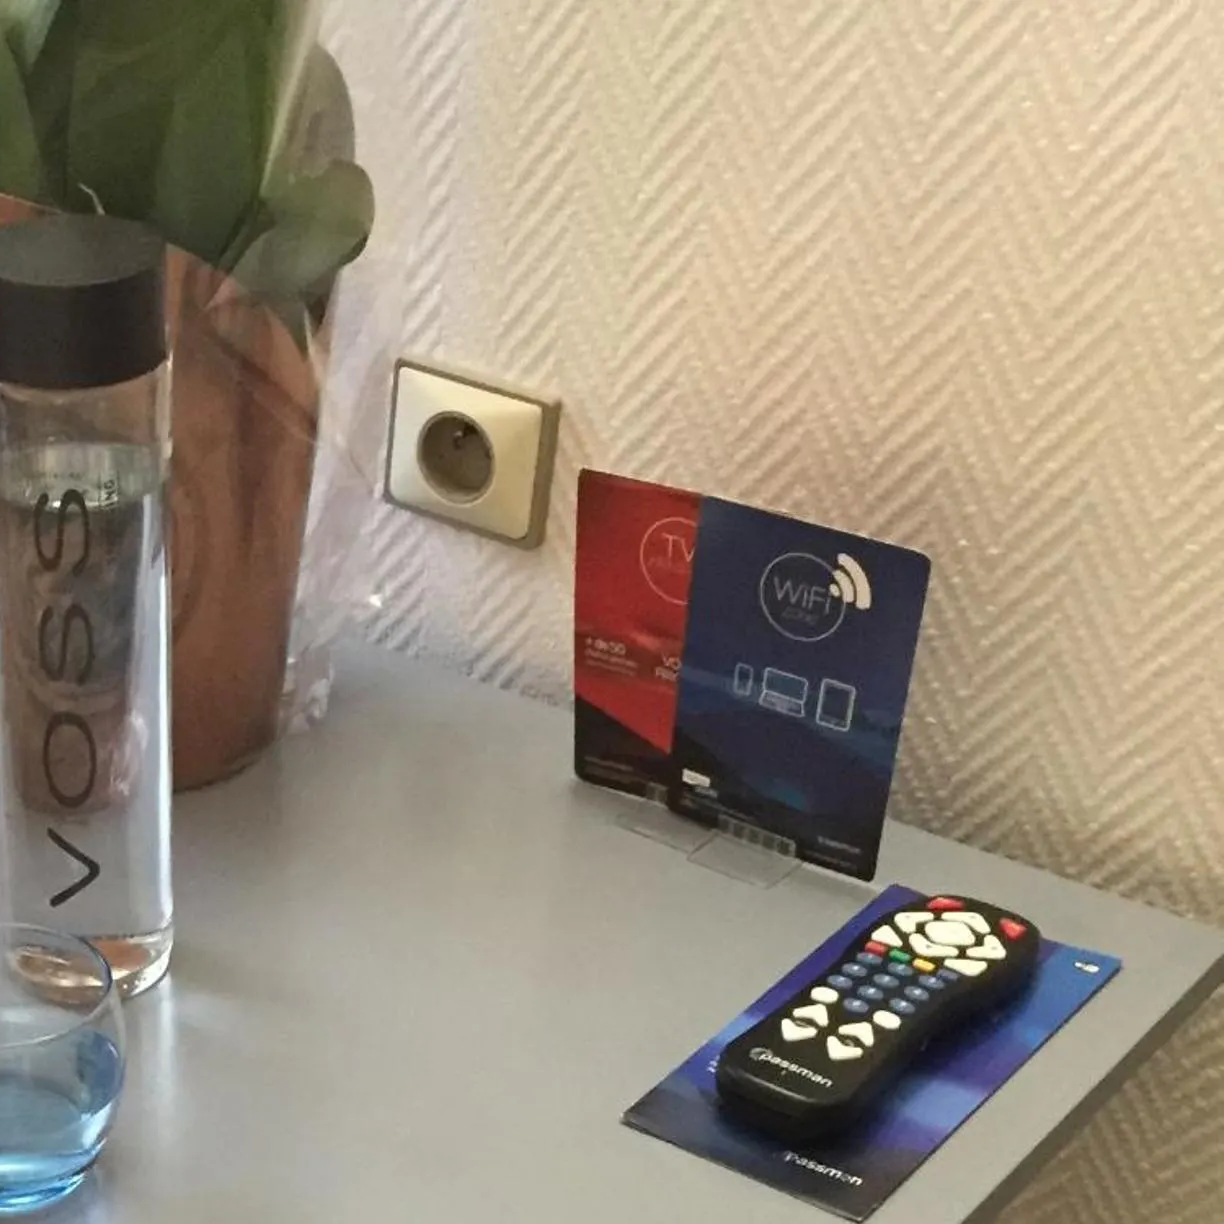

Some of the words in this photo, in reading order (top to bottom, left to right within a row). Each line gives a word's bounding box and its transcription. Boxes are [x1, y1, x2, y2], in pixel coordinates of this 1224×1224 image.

[661, 531, 695, 562] TV
[34, 488, 100, 908] VOSS
[754, 1048, 833, 1088] passman
